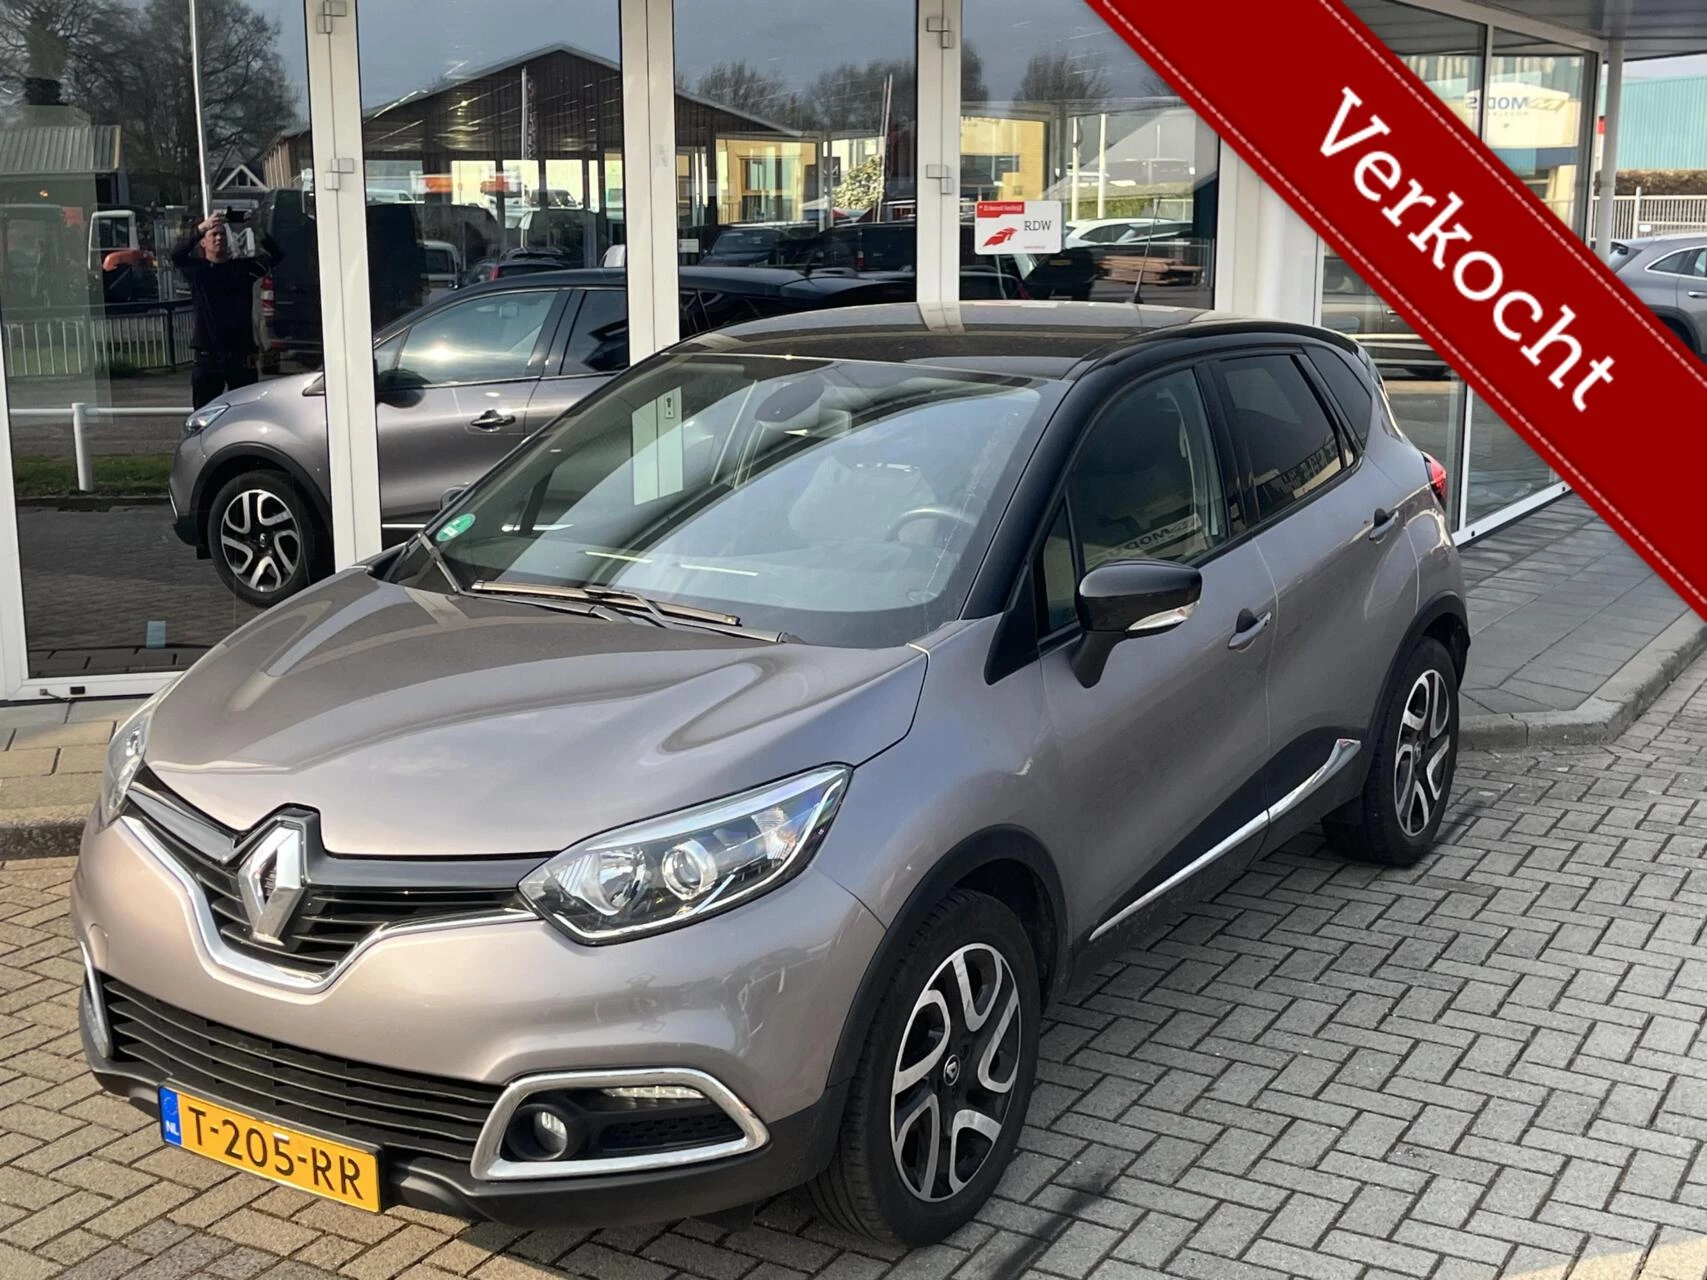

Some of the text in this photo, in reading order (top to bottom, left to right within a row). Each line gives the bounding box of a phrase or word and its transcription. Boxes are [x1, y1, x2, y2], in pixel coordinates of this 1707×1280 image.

[1023, 220, 1052, 231] RDW
[165, 1120, 180, 1136] NL
[187, 1105, 364, 1201] T-205-RR
